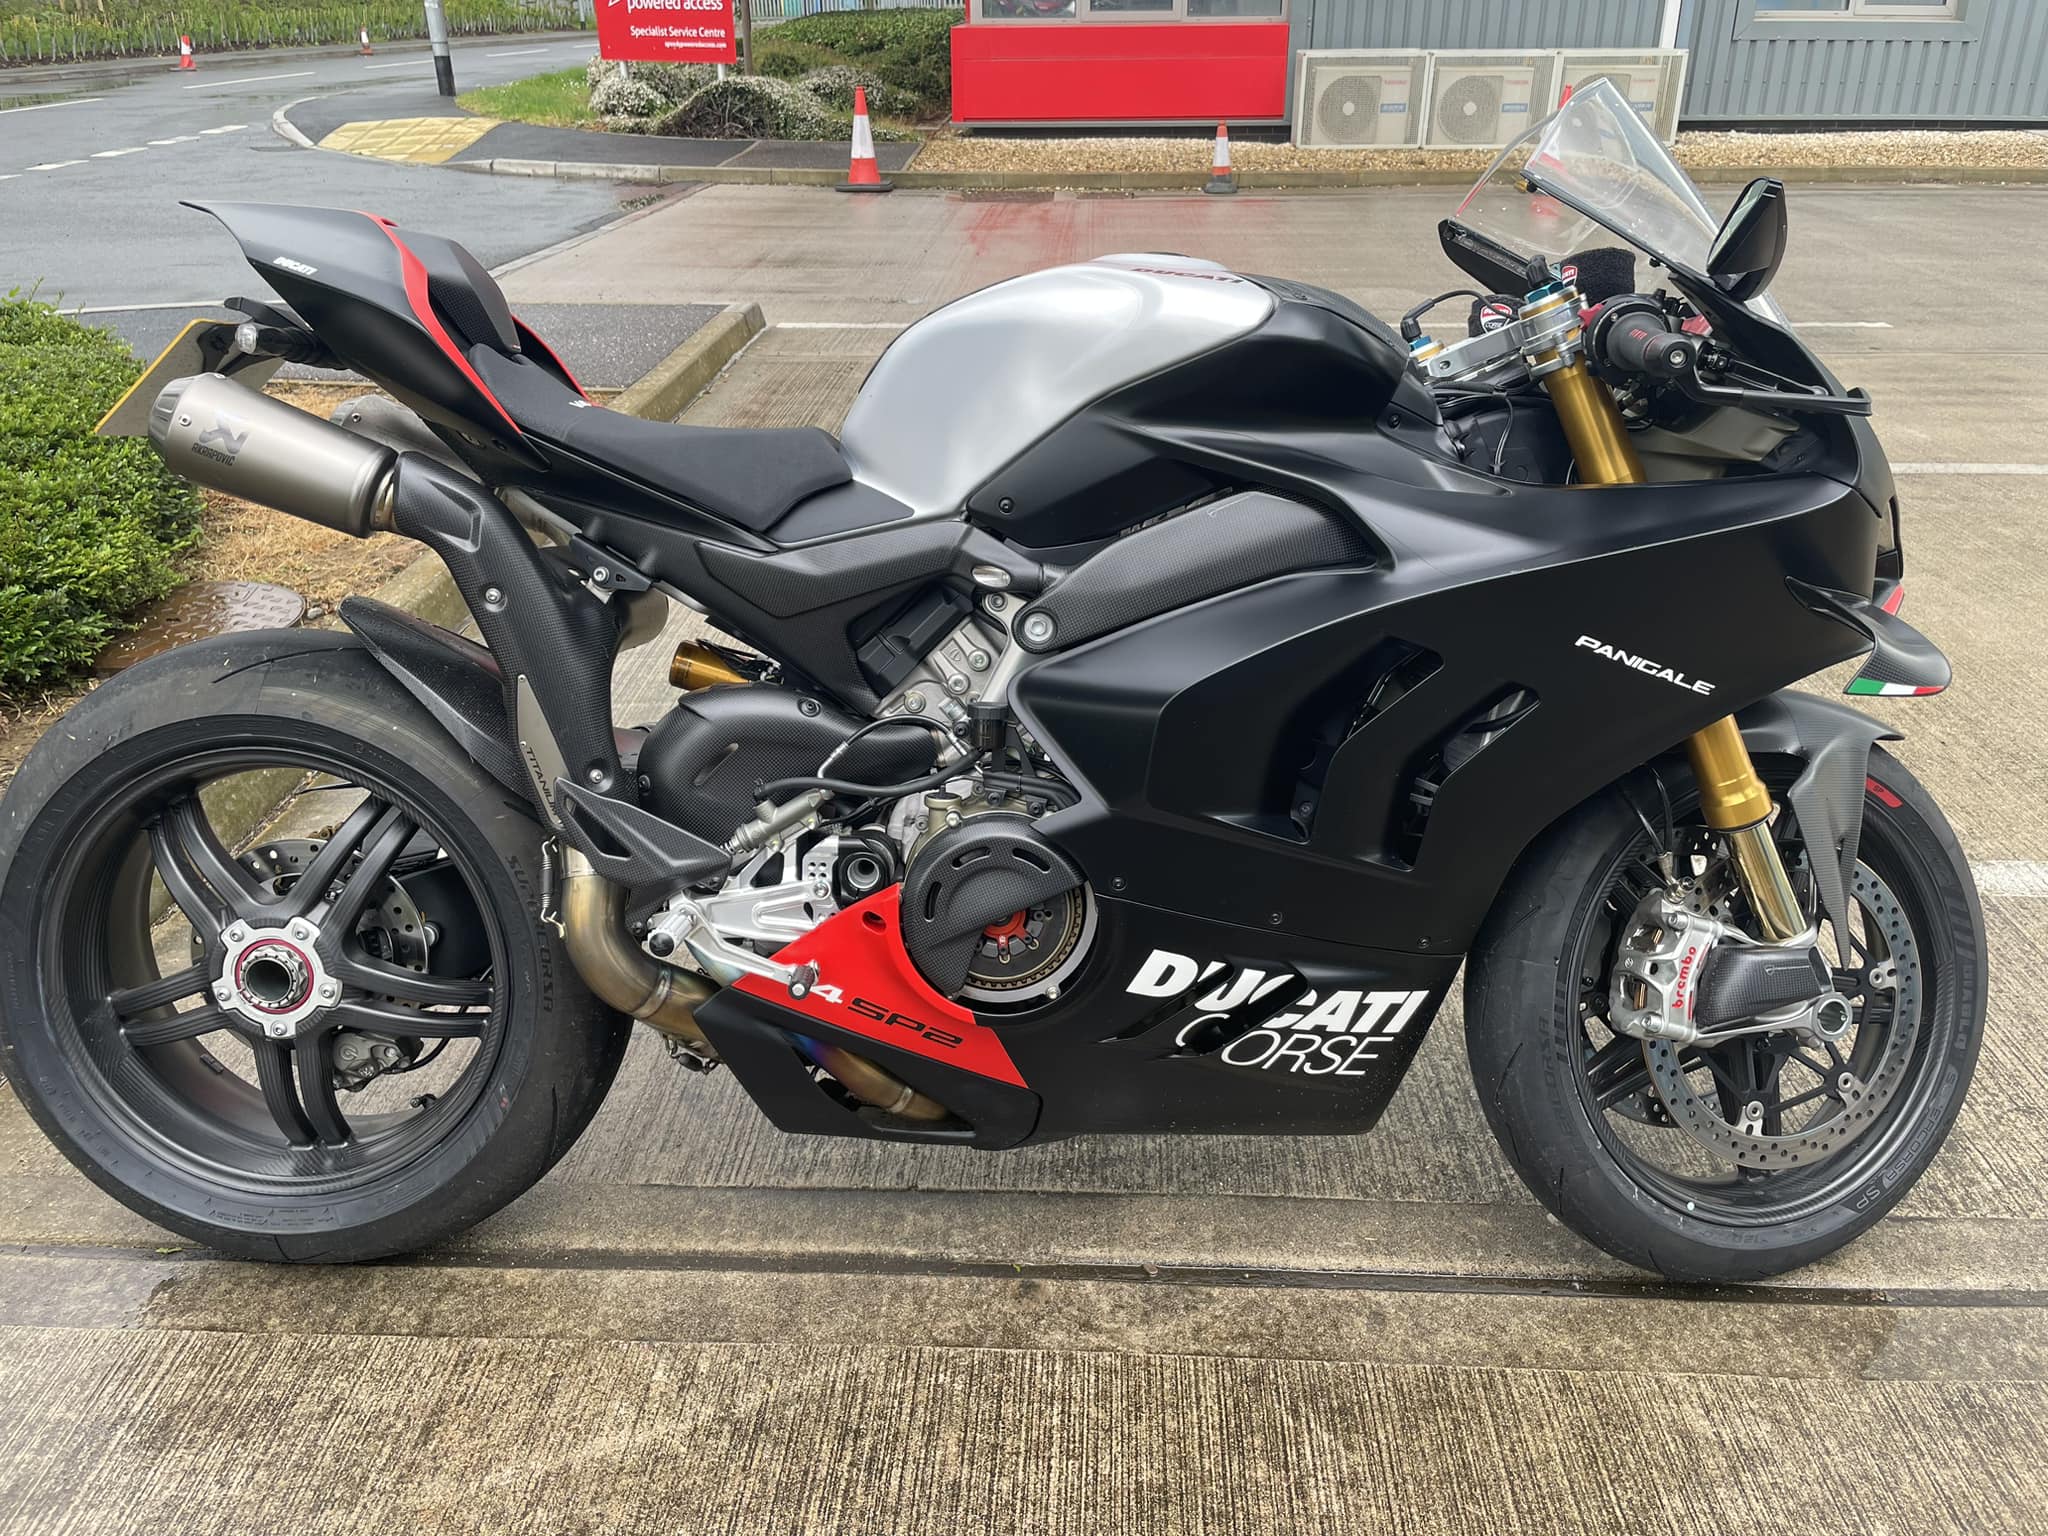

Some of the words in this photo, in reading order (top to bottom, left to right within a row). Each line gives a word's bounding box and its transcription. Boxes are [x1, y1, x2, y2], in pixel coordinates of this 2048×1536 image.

[626, 0, 681, 14] powered
[683, 0, 723, 10] access
[630, 25, 668, 39] Specialist
[668, 26, 698, 37] Service
[699, 26, 726, 38] Centre
[272, 256, 318, 275] DUCATI
[1129, 267, 1245, 284] DUCATI
[1574, 635, 1716, 696] PANIGALE
[1671, 946, 1697, 1009] brembo
[847, 997, 964, 1049] SP2
[1175, 1013, 1394, 1076] CORSE
[1886, 1063, 1959, 1181] SERCORSA
[1856, 1185, 1881, 1210] SP
